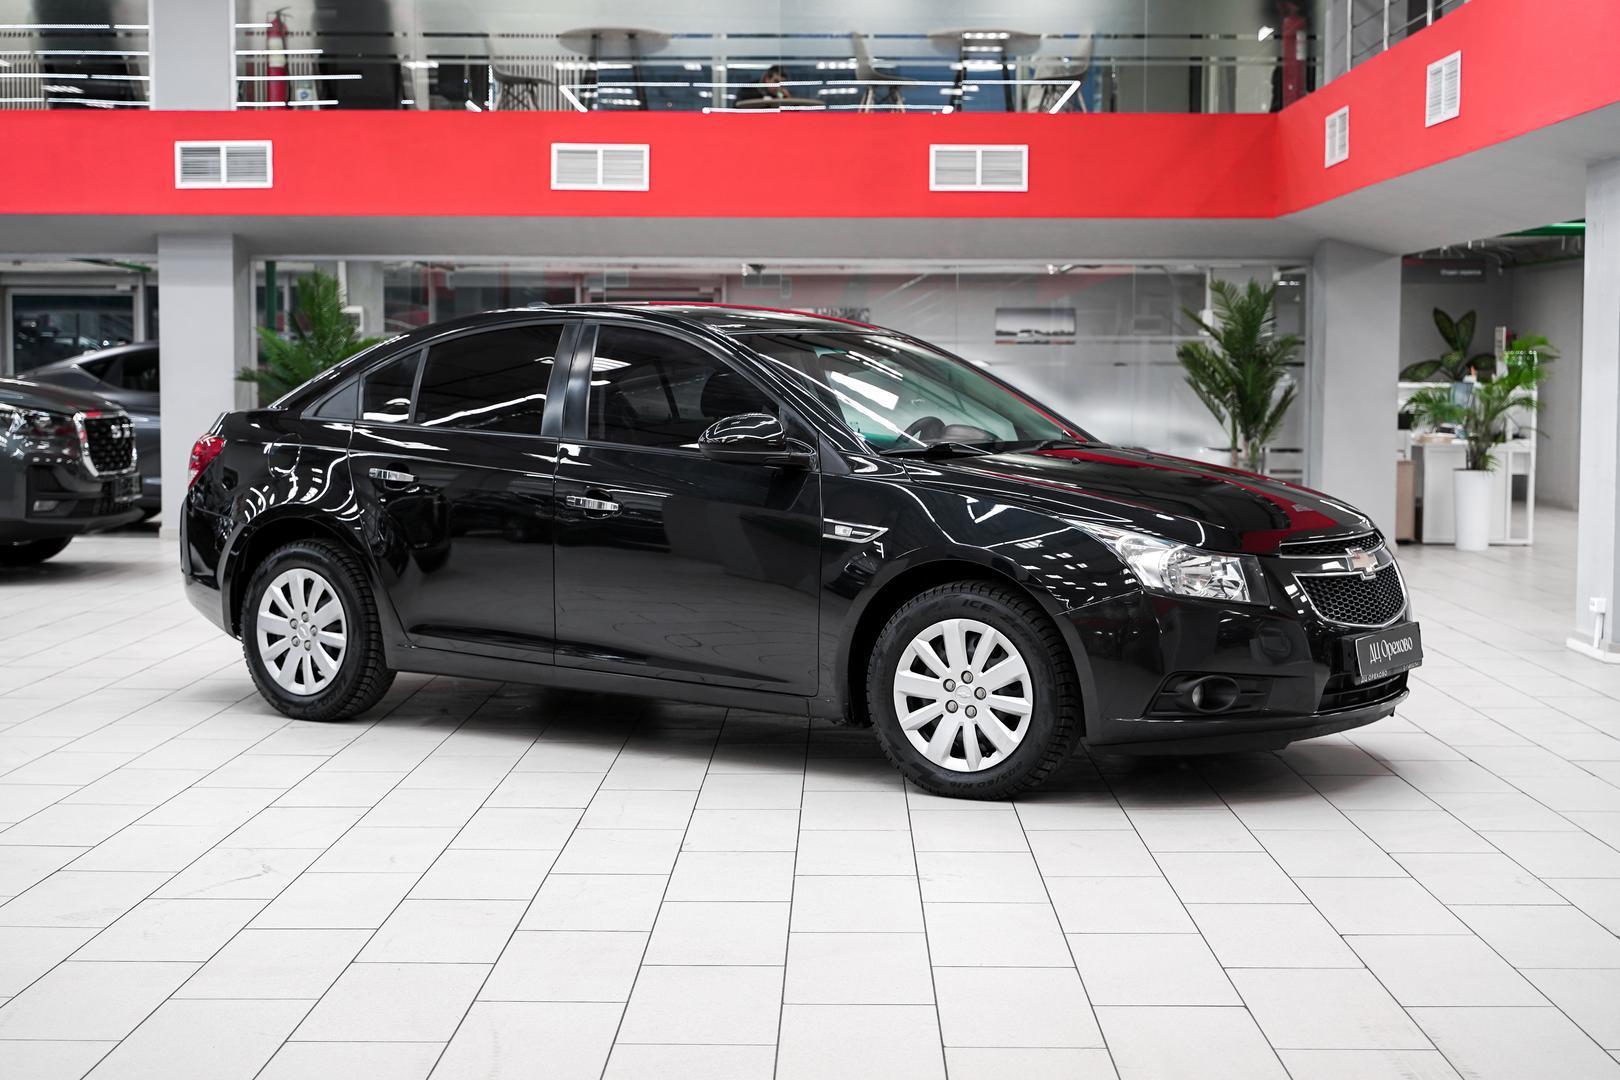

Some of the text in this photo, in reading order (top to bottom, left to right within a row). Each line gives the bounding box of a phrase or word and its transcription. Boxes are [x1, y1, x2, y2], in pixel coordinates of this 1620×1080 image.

[961, 598, 994, 612] ICE
[1369, 636, 1413, 665] ДЦ Орехово
